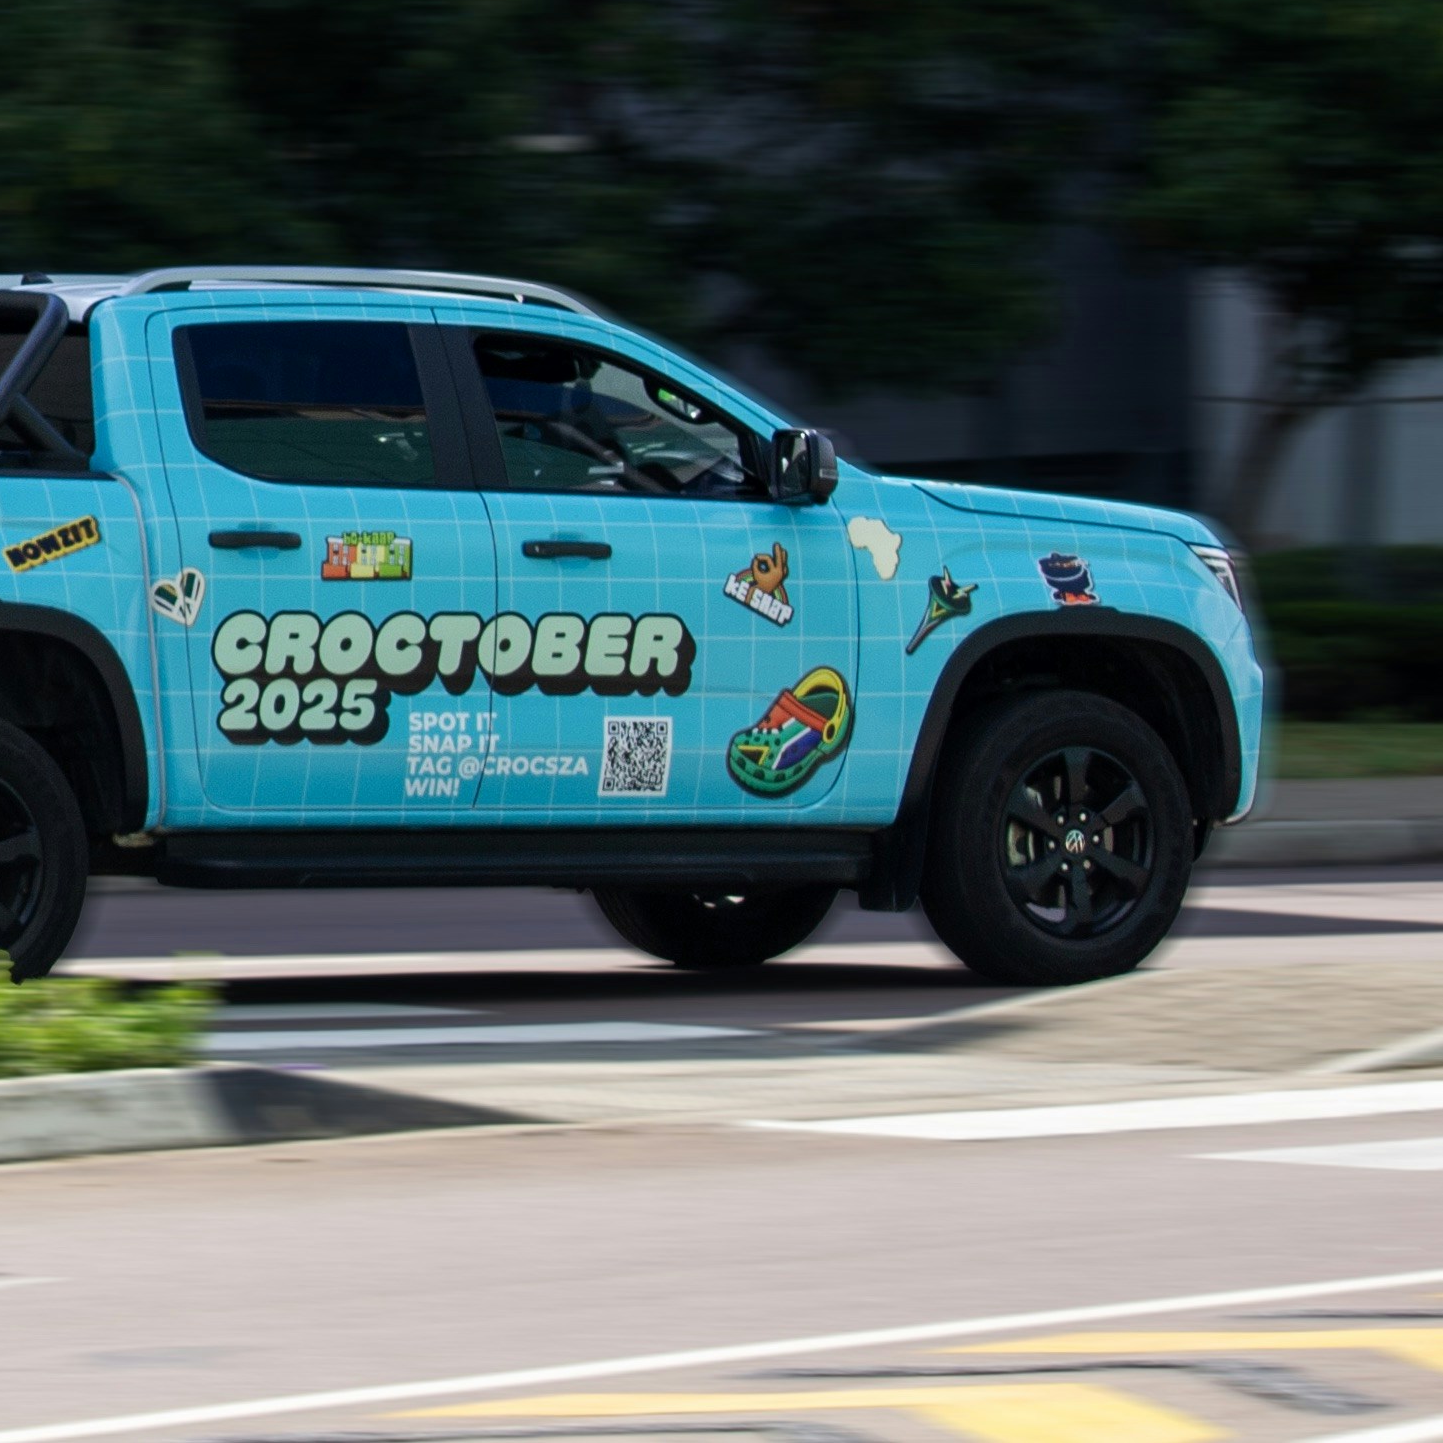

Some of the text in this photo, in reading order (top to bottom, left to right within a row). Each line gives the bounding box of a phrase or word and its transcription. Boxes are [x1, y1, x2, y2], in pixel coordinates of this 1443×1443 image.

[213, 612, 688, 683] CROCTOBER
[218, 678, 381, 734] 2025
[409, 712, 497, 732] SPOT IT
[409, 734, 500, 753] SNAP IT
[407, 756, 589, 779] TAG @CROCSZA
[404, 777, 461, 797] WIN!
